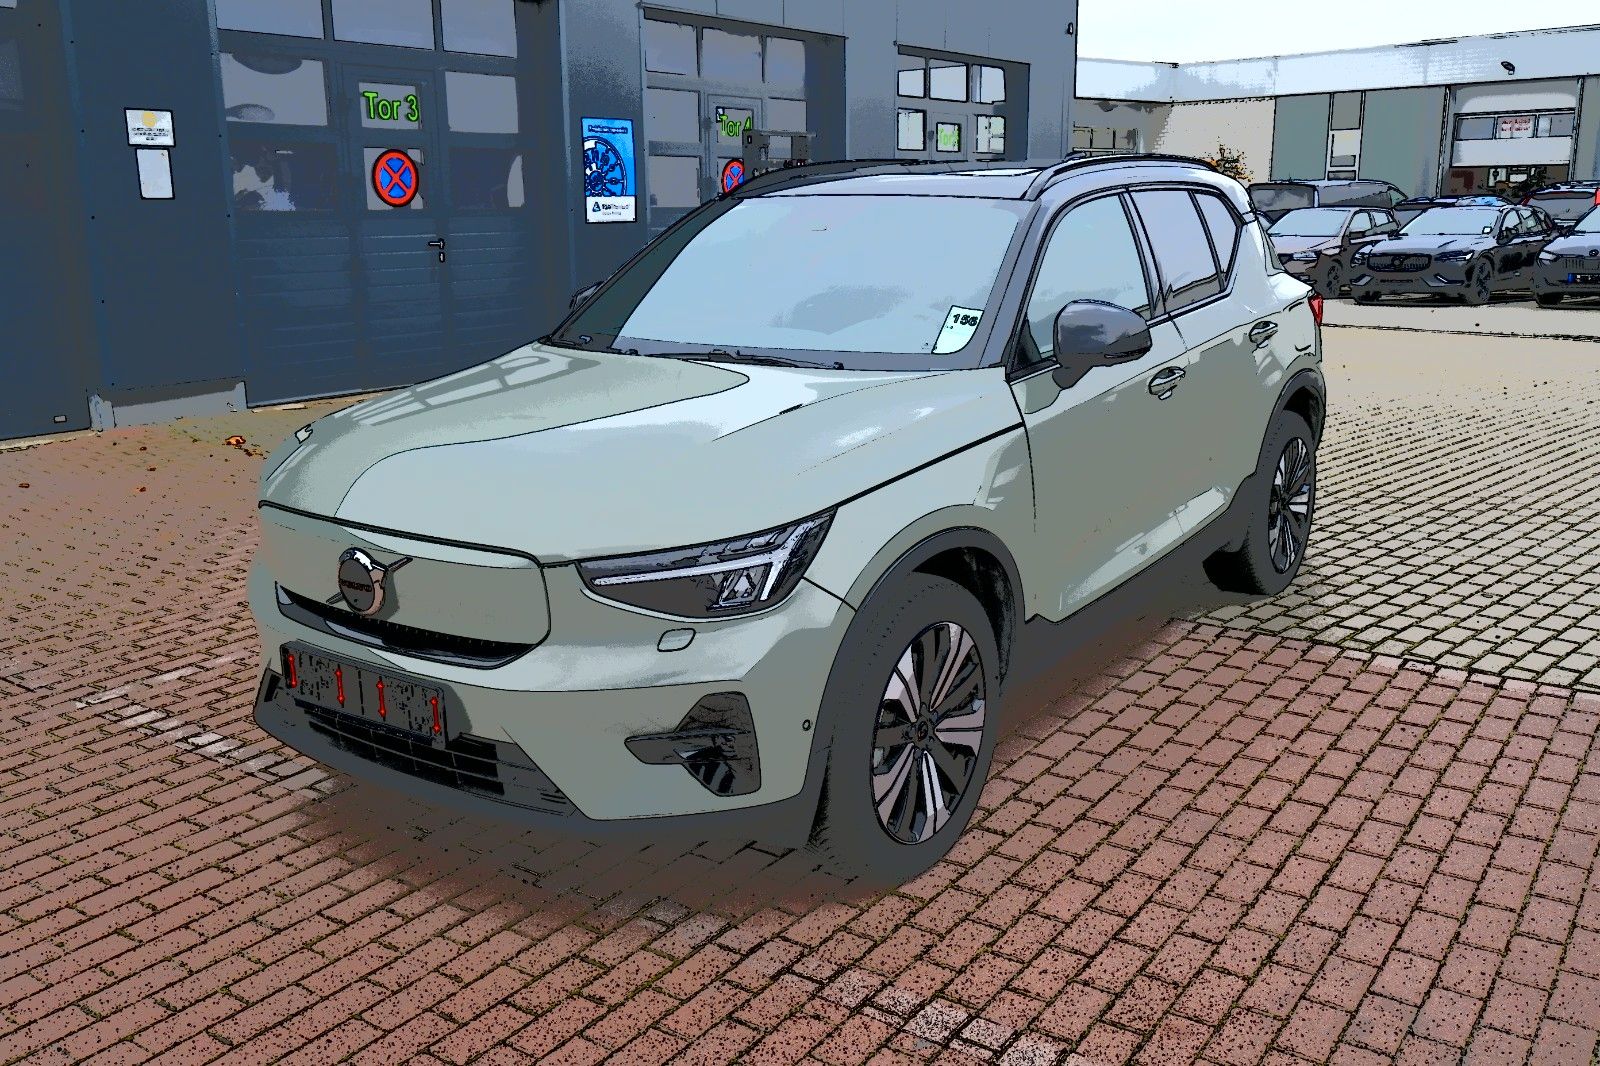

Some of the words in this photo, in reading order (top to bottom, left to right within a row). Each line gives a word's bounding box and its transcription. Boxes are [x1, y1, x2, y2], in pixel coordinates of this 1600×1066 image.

[362, 91, 401, 120] Tor
[405, 94, 420, 122] 3
[719, 115, 741, 137] Tor
